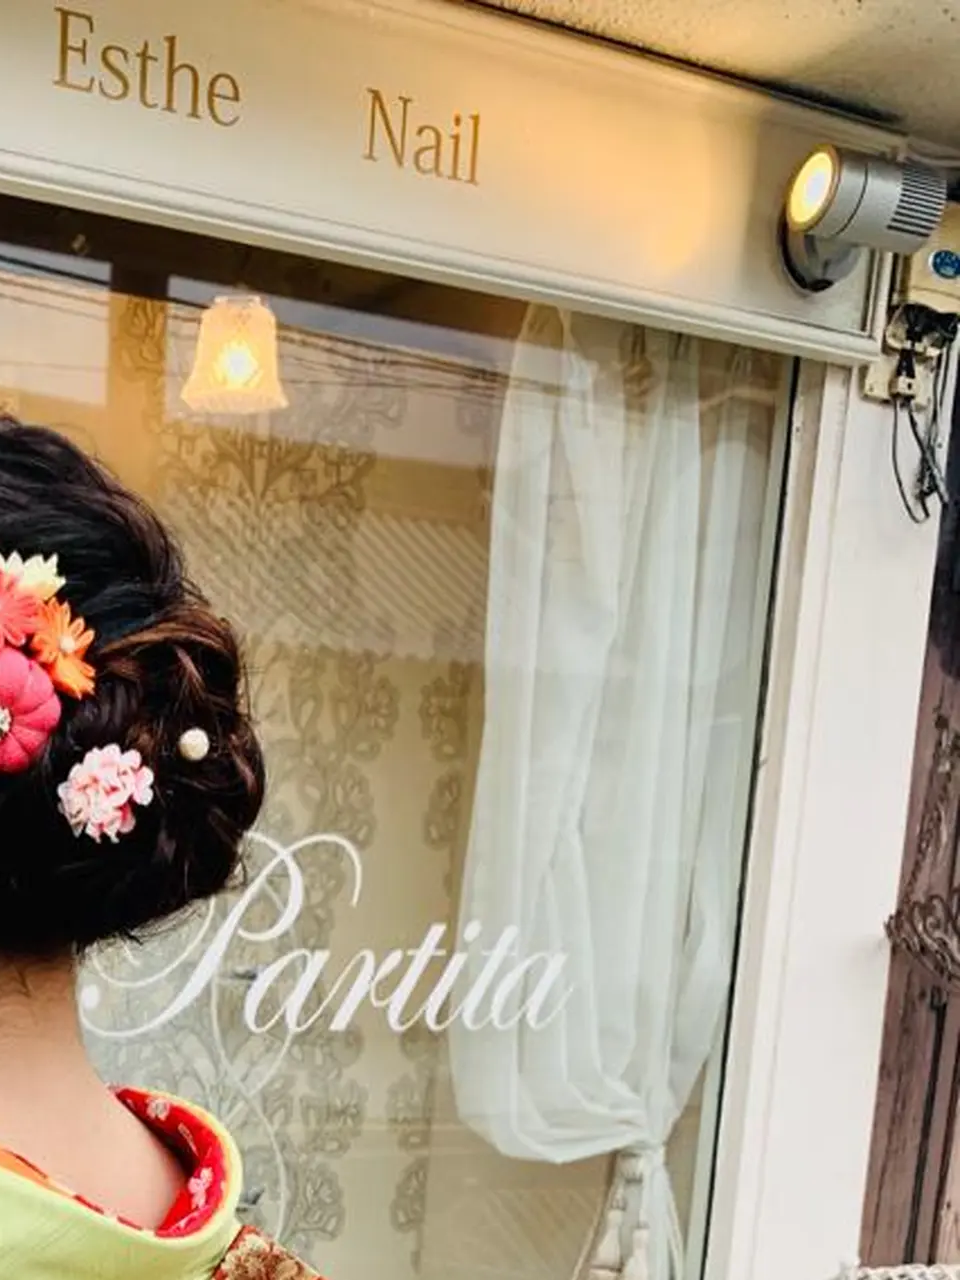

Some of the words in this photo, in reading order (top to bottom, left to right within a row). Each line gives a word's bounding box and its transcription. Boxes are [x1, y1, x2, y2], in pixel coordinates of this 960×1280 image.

[52, 6, 240, 127] Esthe
[362, 87, 481, 186] Nail
[78, 831, 574, 1037] Partita
